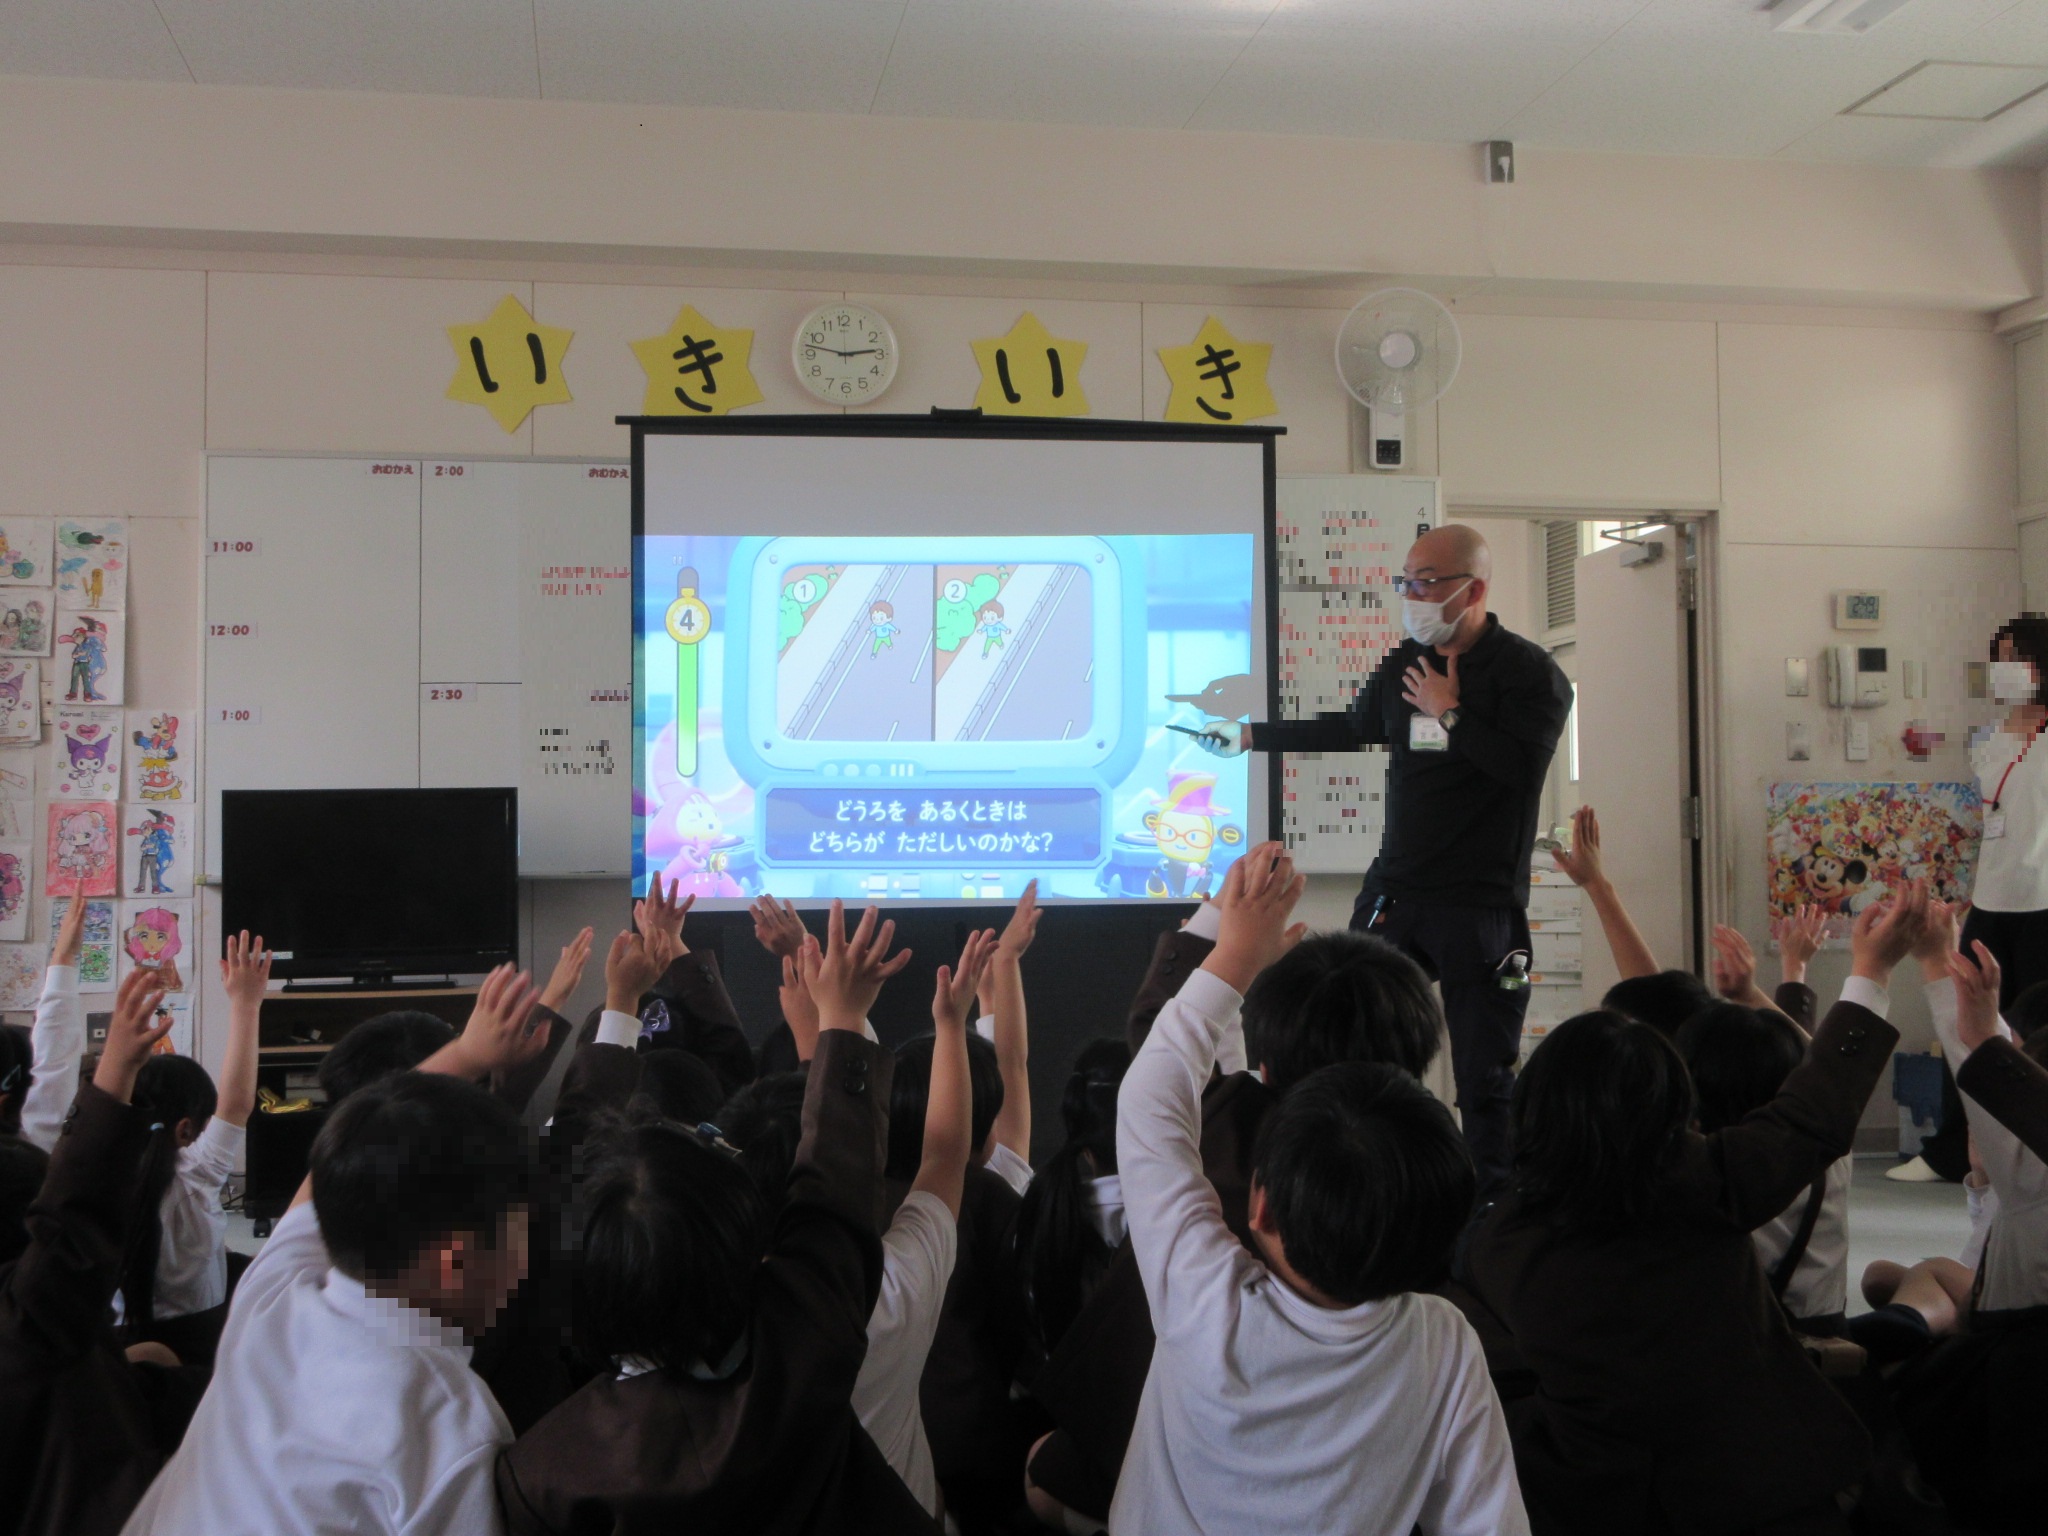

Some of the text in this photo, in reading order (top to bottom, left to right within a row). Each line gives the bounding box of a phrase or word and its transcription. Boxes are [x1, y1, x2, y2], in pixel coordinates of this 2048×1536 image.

[821, 320, 832, 332] 11
[837, 314, 851, 327] 12
[810, 332, 825, 344] 10
[868, 331, 878, 343] 2
[805, 349, 816, 360] 9
[874, 348, 885, 360] 3
[470, 332, 1241, 421] い き い き
[811, 365, 822, 377] 8
[870, 365, 879, 376] 4
[825, 378, 835, 389] 7
[841, 382, 852, 394] 6
[858, 377, 868, 389] 5
[371, 464, 414, 475] おむかえ
[434, 465, 464, 477] 2:00
[588, 468, 630, 479] おむかえ
[213, 541, 254, 553] 11:00
[950, 584, 961, 599] 2
[679, 609, 695, 631] 4
[210, 625, 250, 636] 12:00
[430, 689, 463, 700] 2:30
[221, 710, 250, 721] 1:00
[835, 800, 1028, 822] どうろを あるくときは
[808, 831, 1054, 853] どちらが ただしいのかな?
